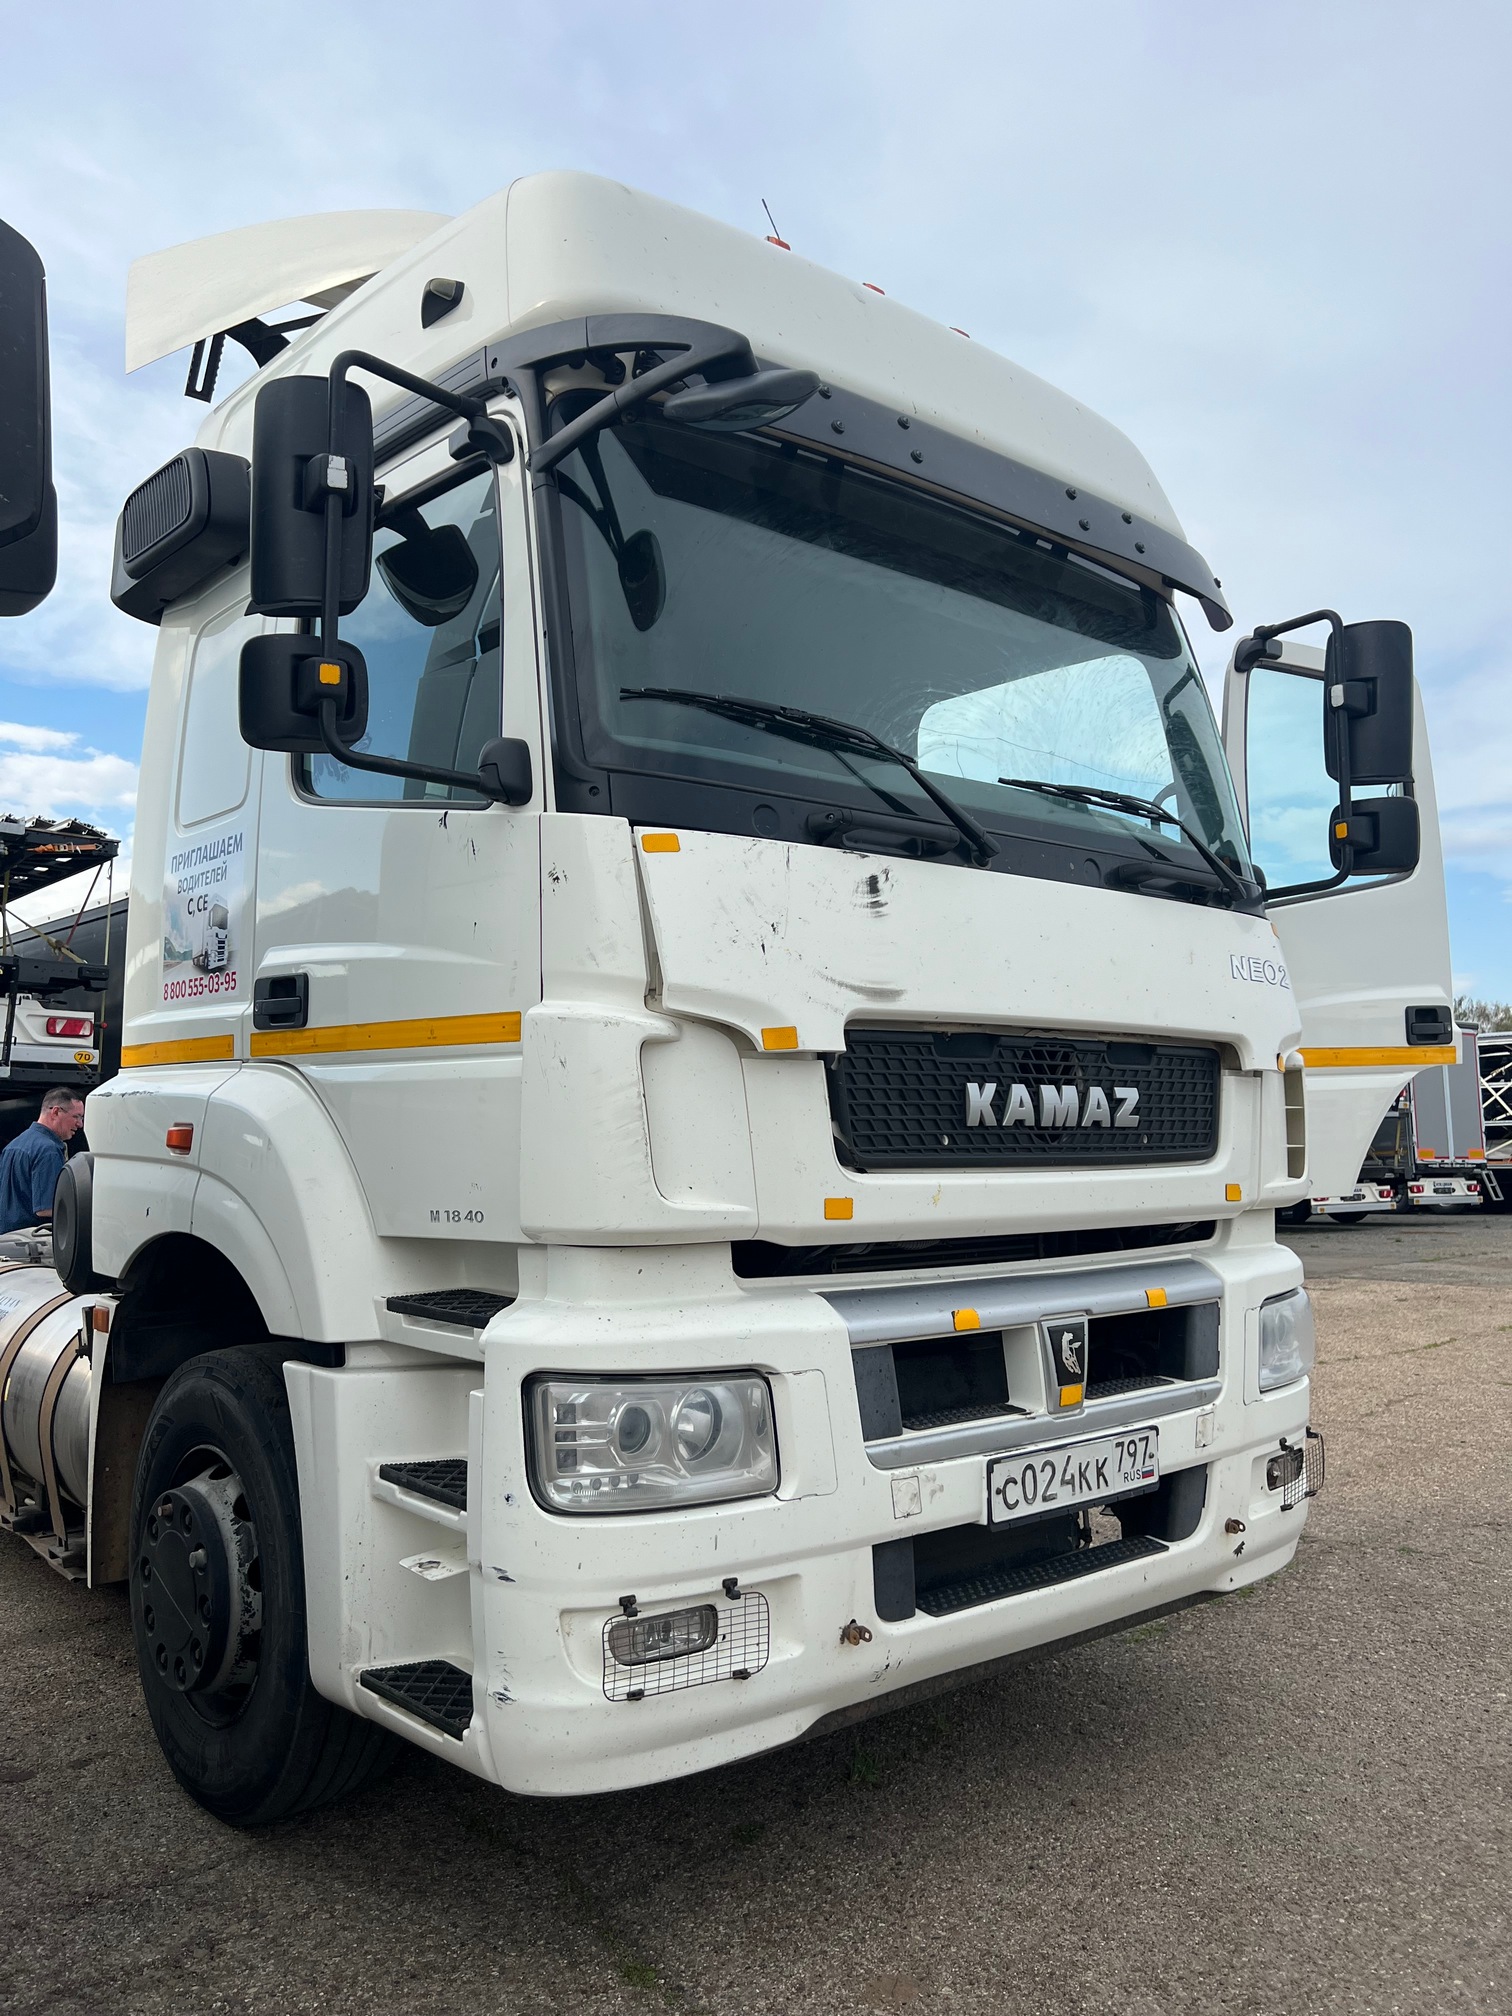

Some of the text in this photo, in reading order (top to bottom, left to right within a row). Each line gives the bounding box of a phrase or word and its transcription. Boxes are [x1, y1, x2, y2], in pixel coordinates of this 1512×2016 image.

[170, 831, 243, 875] ПРИГЛАШАЕМ
[177, 859, 228, 895] ВОДИТЕЛЕЙ
[163, 970, 237, 1001] 8 800 555-03-95
[964, 1081, 1141, 1128] KAMAZ
[1114, 1435, 1150, 1473] 797
[1123, 1471, 1142, 1484] RUS
